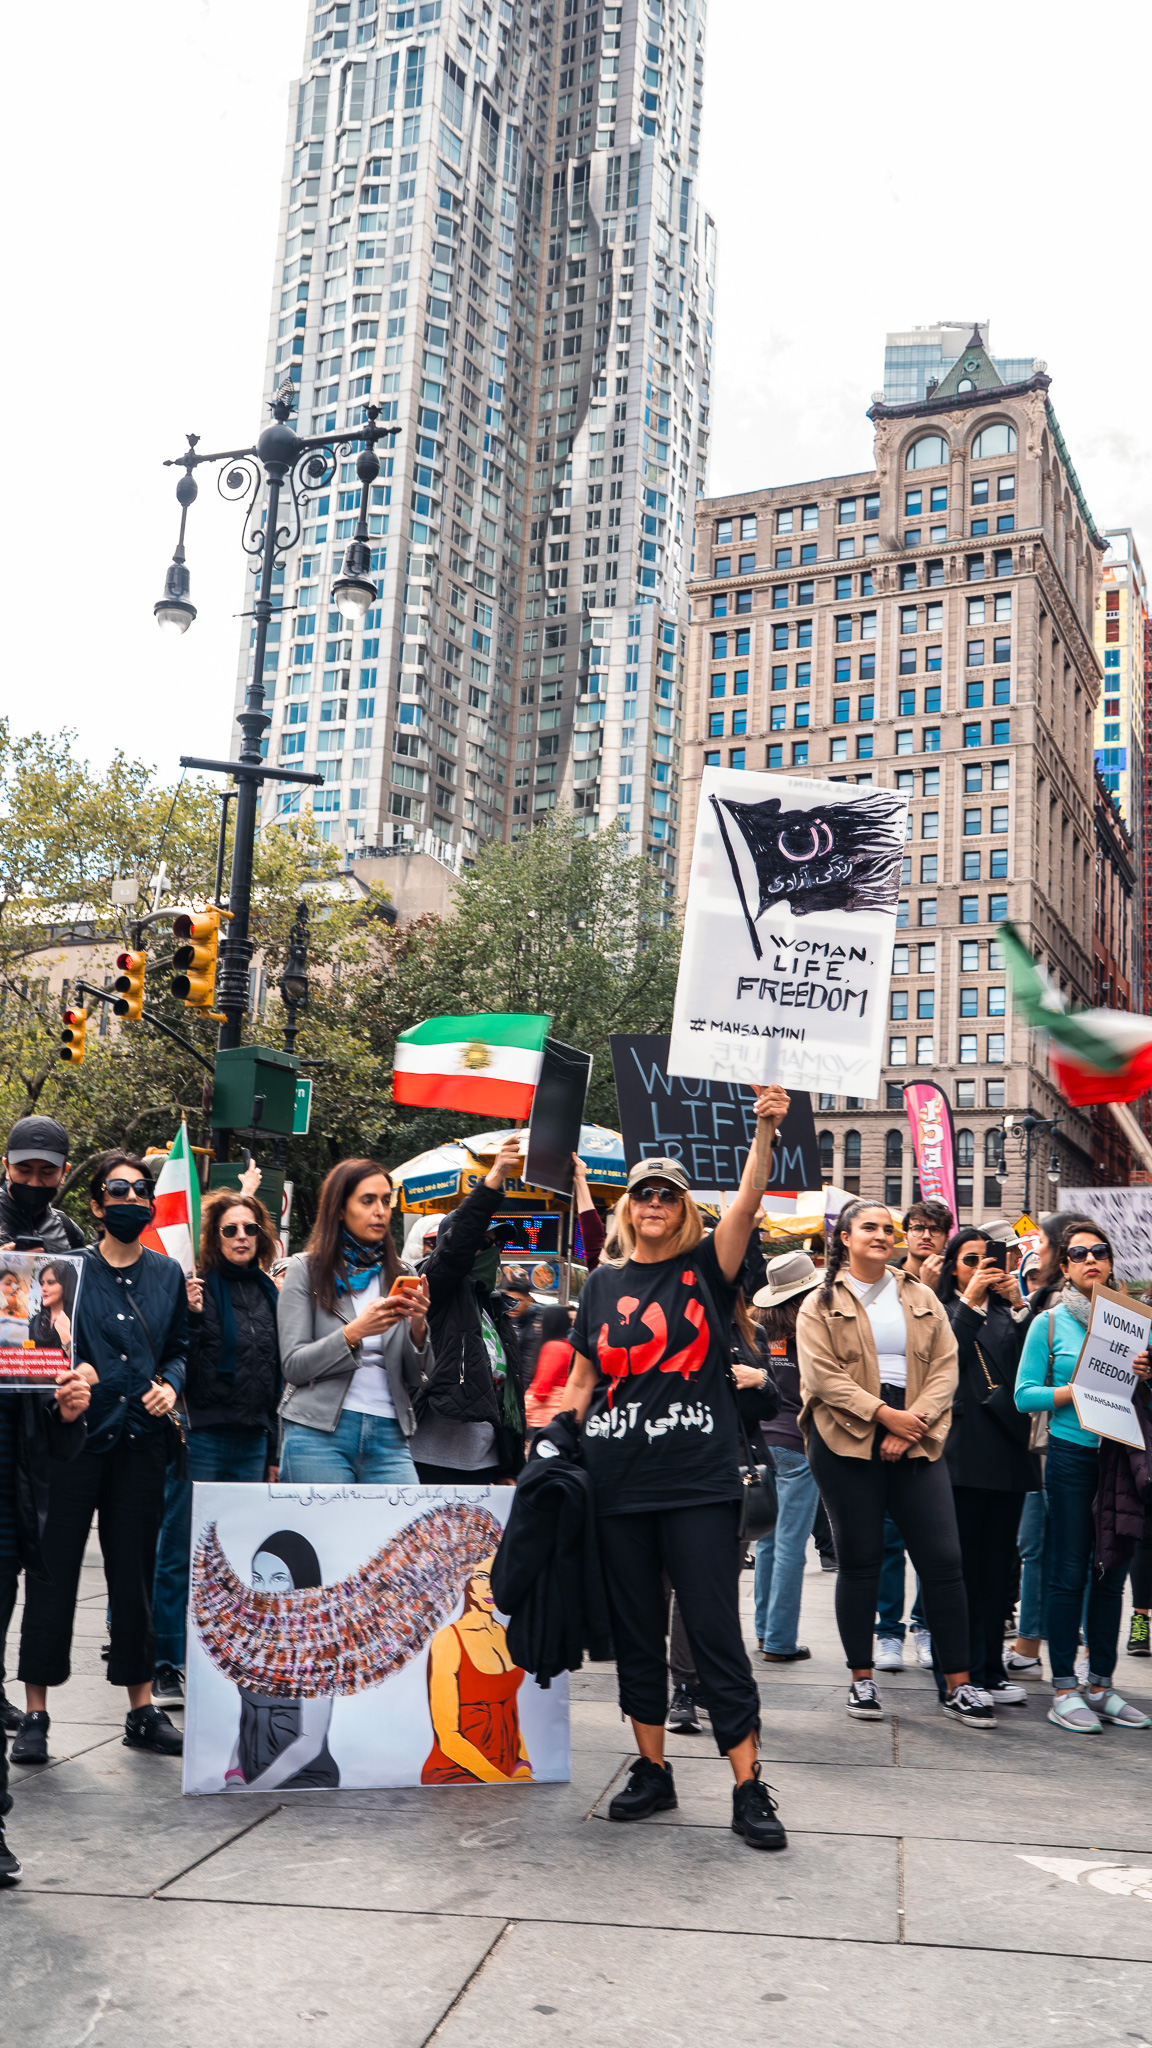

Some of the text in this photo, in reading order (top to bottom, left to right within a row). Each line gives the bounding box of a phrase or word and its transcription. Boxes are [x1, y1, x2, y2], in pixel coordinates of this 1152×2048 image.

[778, 818, 833, 862] زن
[770, 934, 874, 966] WOMAN,
[773, 955, 850, 984] LIFE,
[736, 976, 868, 1018] FREEDOM
[597, 1270, 710, 1409] زن
[1103, 1311, 1144, 1340] WOMAN
[1109, 1340, 1131, 1358] LIFE
[1088, 1357, 1136, 1387] FREEDOM
[1084, 1393, 1132, 1414] #MAHSAAMINI
[585, 1402, 714, 1444] زندگی آزادی
